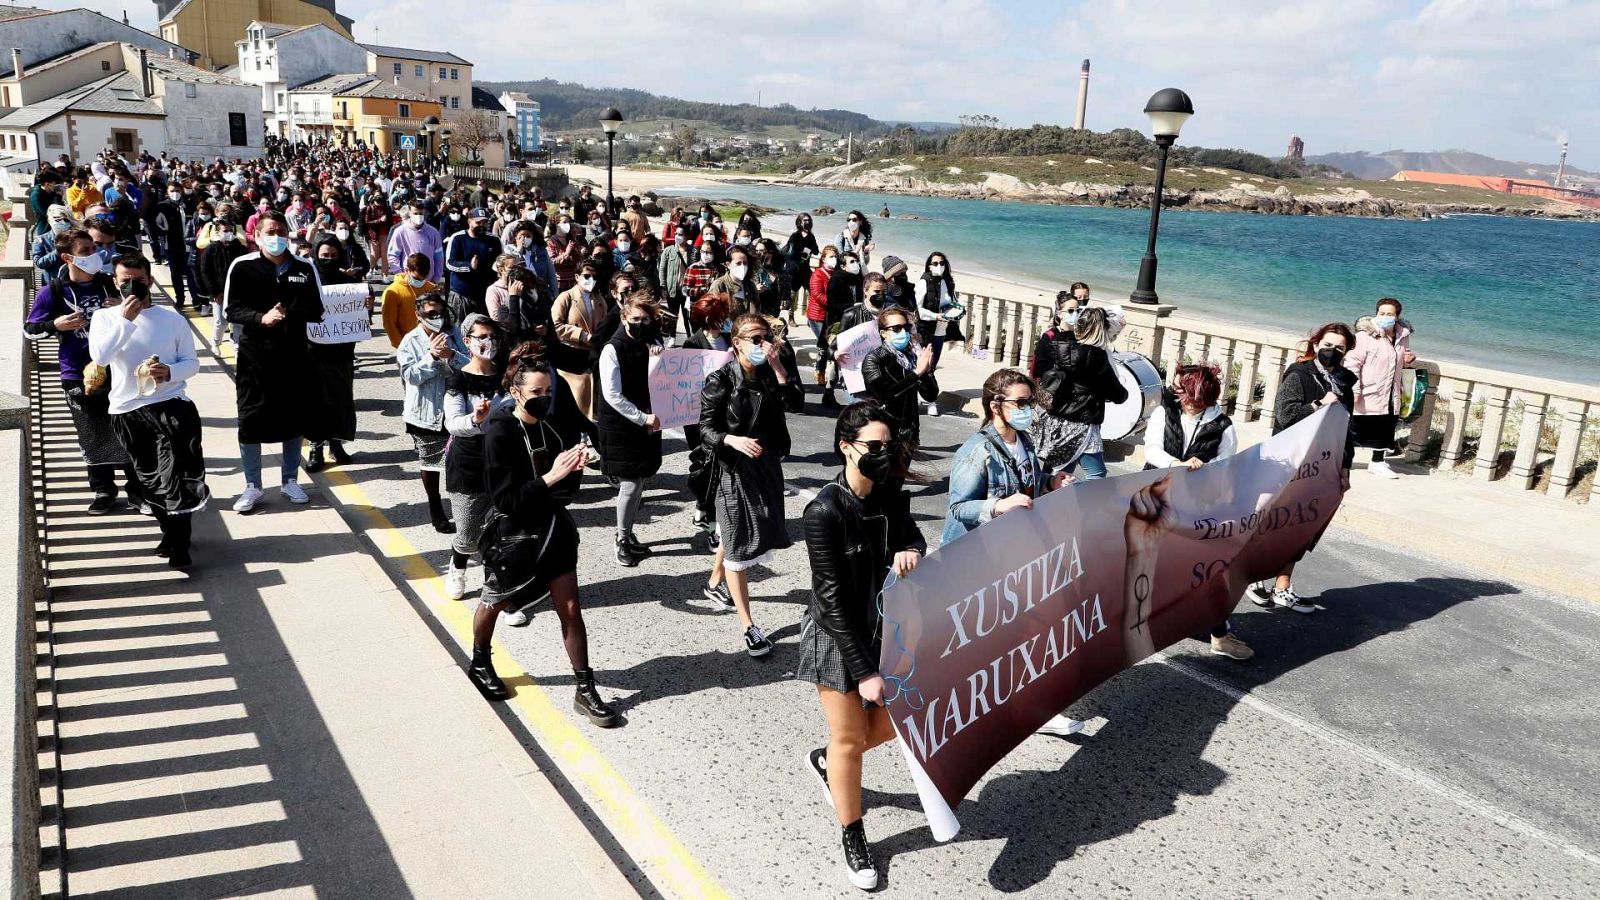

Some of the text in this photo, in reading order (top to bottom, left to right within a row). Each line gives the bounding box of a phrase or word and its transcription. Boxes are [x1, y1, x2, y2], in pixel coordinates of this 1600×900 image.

[333, 323, 340, 336] A
[656, 352, 714, 376] ASUSTA
[677, 380, 692, 389] NON
[940, 535, 1085, 659] XUSTIZA
[902, 593, 1108, 764] MARUXAINA
